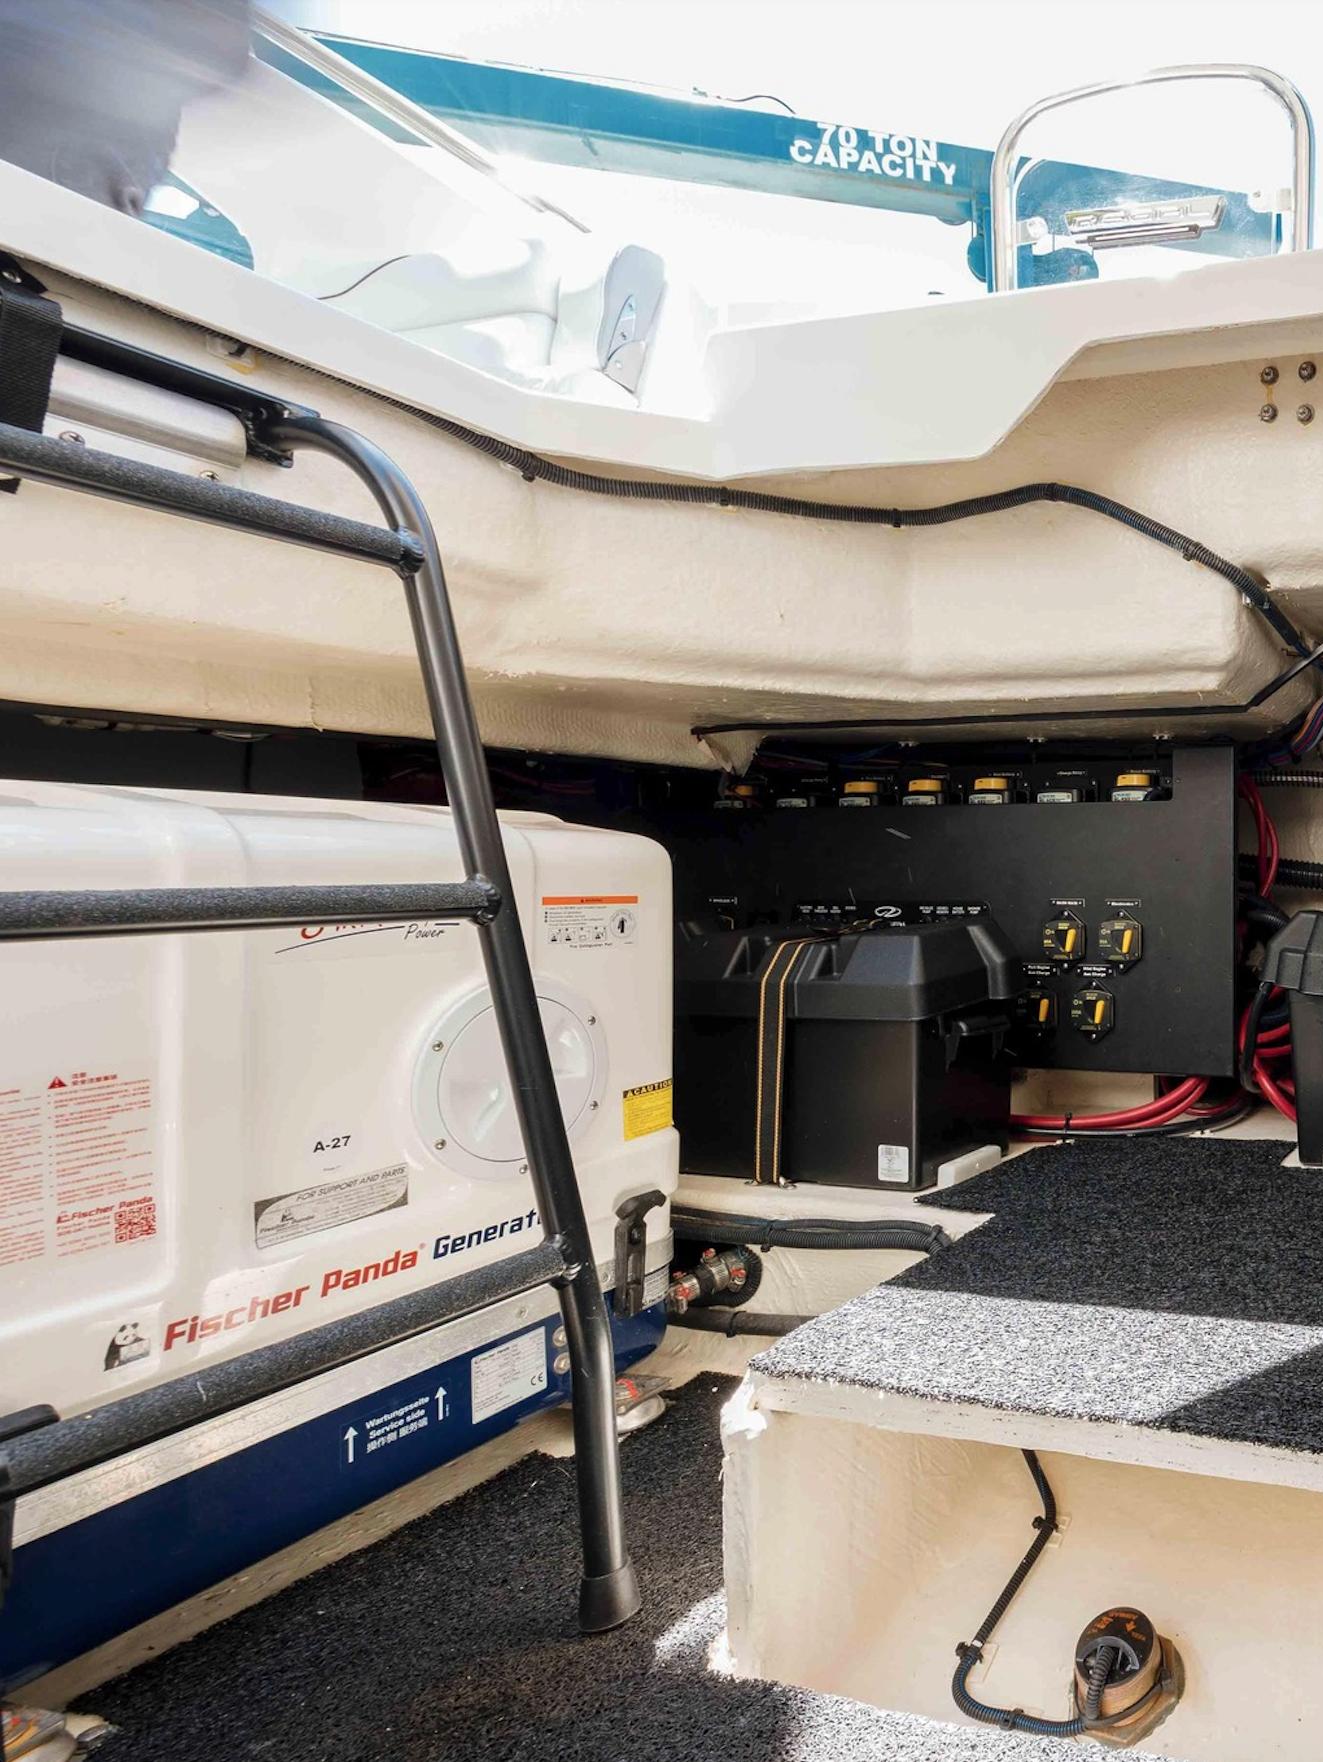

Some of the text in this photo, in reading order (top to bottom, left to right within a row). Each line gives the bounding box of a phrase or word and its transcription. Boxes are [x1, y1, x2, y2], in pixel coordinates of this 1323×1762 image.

[817, 122, 939, 162] 70 TON
[789, 139, 957, 185] CAPACITY
[404, 923, 446, 940] Power
[313, 1134, 352, 1154] A-27
[295, 1166, 407, 1202] FOR SUPPORT AND PARTS
[71, 1195, 154, 1222] Fischer Panda
[163, 1283, 310, 1352] Fischer
[433, 1208, 541, 1259] Generat
[365, 1396, 430, 1429] Wartungsseite
[369, 1408, 426, 1439] Service side
